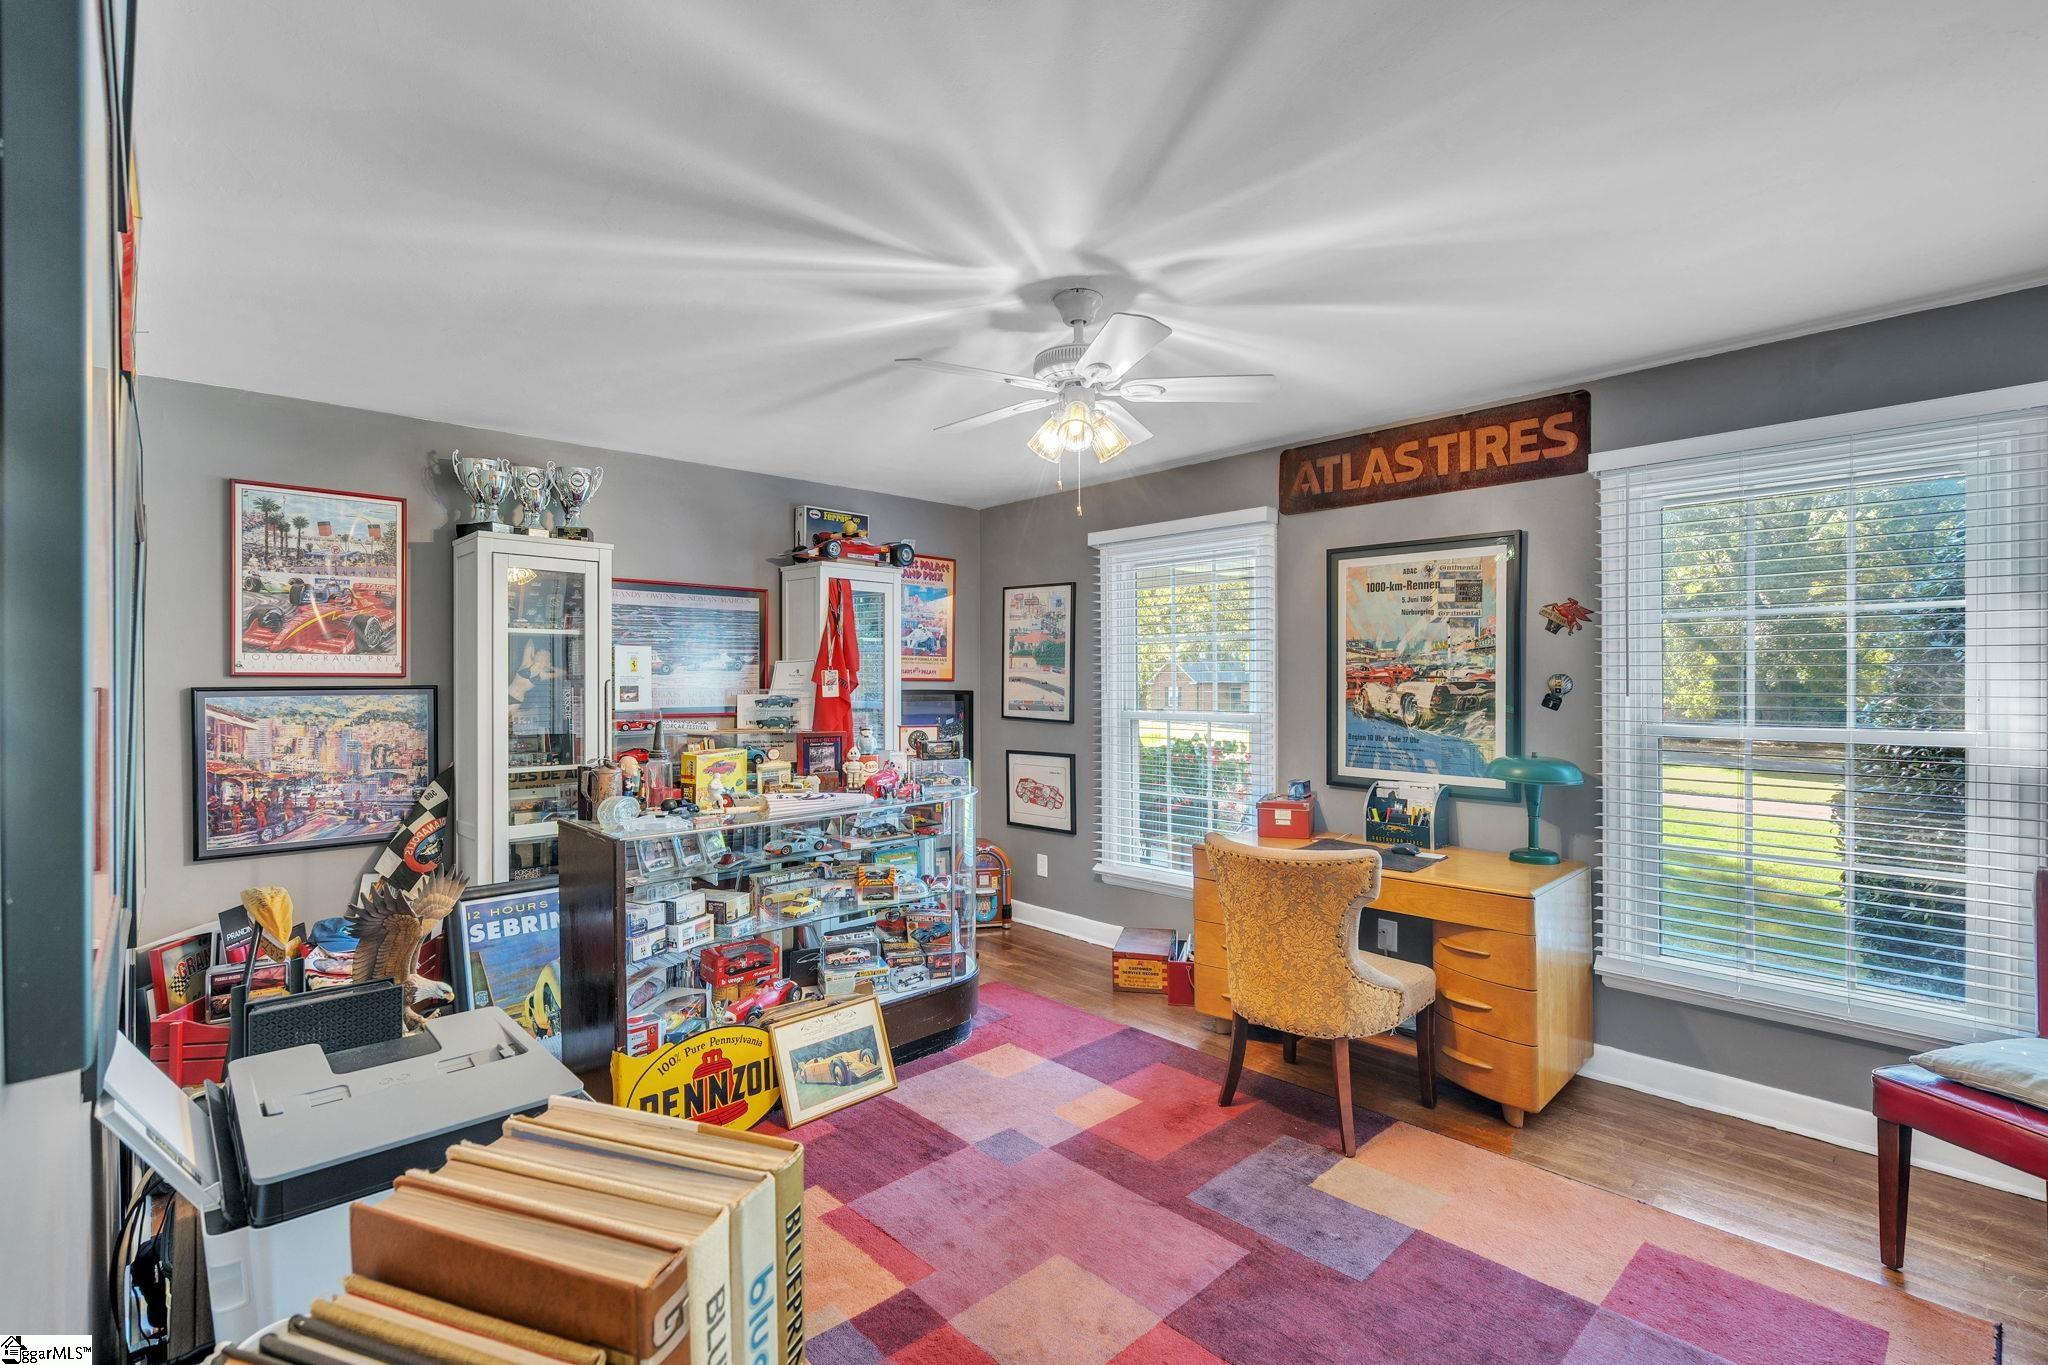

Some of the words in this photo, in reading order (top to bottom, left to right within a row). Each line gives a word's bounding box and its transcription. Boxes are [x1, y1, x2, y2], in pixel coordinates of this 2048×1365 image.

[1291, 440, 1423, 495] ATLAS
[1428, 411, 1579, 476] TIRES
[1402, 567, 1418, 575] ADAC
[1366, 579, 1441, 593] 1000-km-Rennen
[242, 653, 303, 662] TOYOTA
[310, 654, 362, 662] GRAND
[368, 654, 398, 663] PRIX
[467, 910, 481, 921] 12
[490, 900, 549, 917] HOURS
[469, 912, 560, 943] SEBRIN
[683, 1042, 706, 1058] Pure
[709, 1036, 763, 1048] Pennsylvania
[785, 1202, 803, 1365] BLUEPRIN
